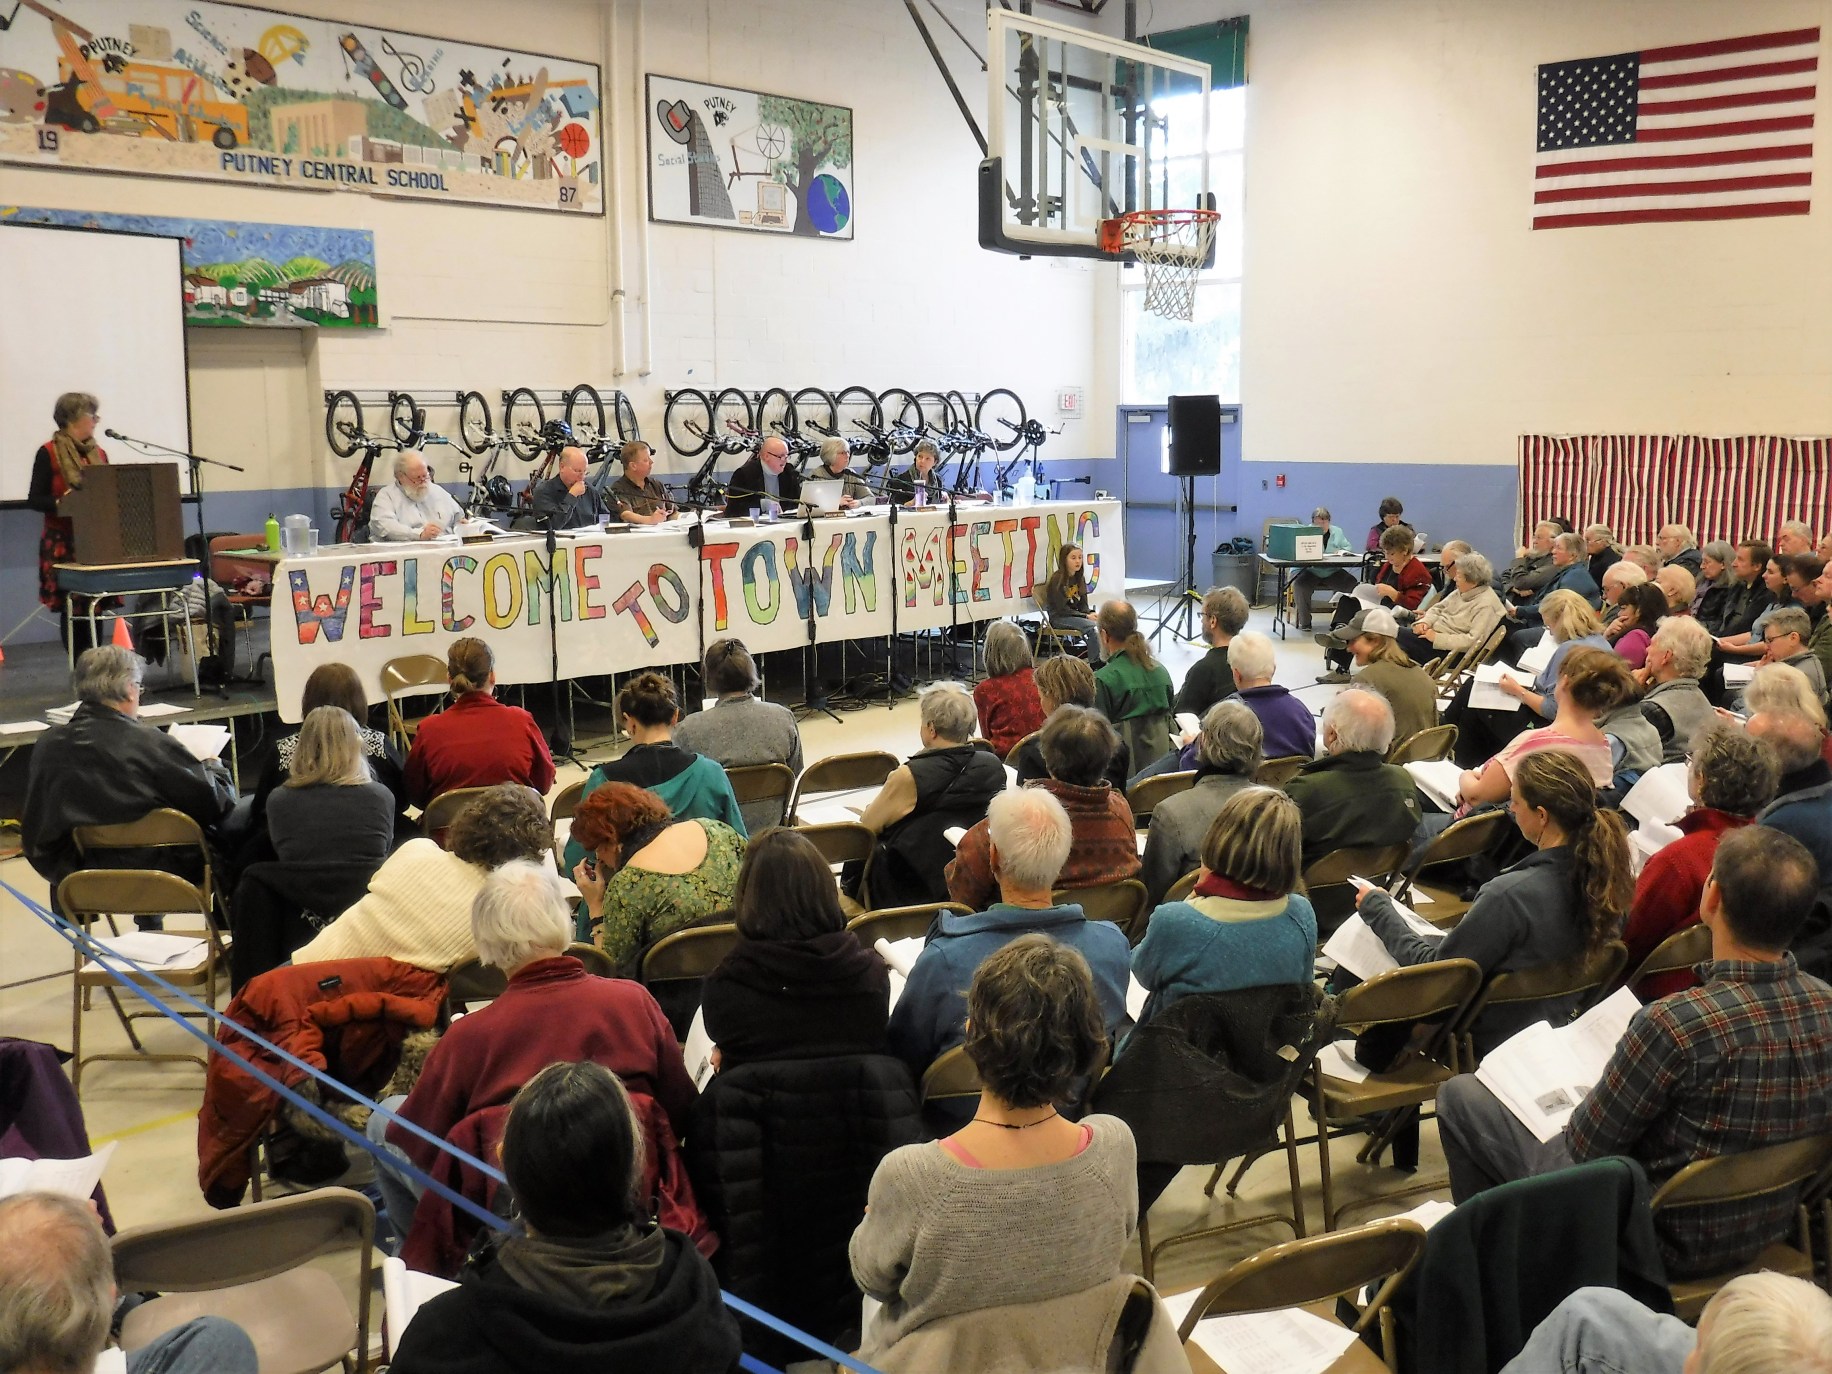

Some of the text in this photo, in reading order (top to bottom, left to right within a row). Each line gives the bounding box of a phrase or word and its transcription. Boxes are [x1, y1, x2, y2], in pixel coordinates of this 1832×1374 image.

[704, 97, 737, 114] PUTNEY
[38, 130, 58, 151] 19
[658, 152, 686, 166] Social
[221, 152, 449, 192] PUTNEY CENTRAL SCHOOL
[559, 186, 577, 203] 87
[288, 510, 1101, 648] WELCOME TO TOWN MEETING
